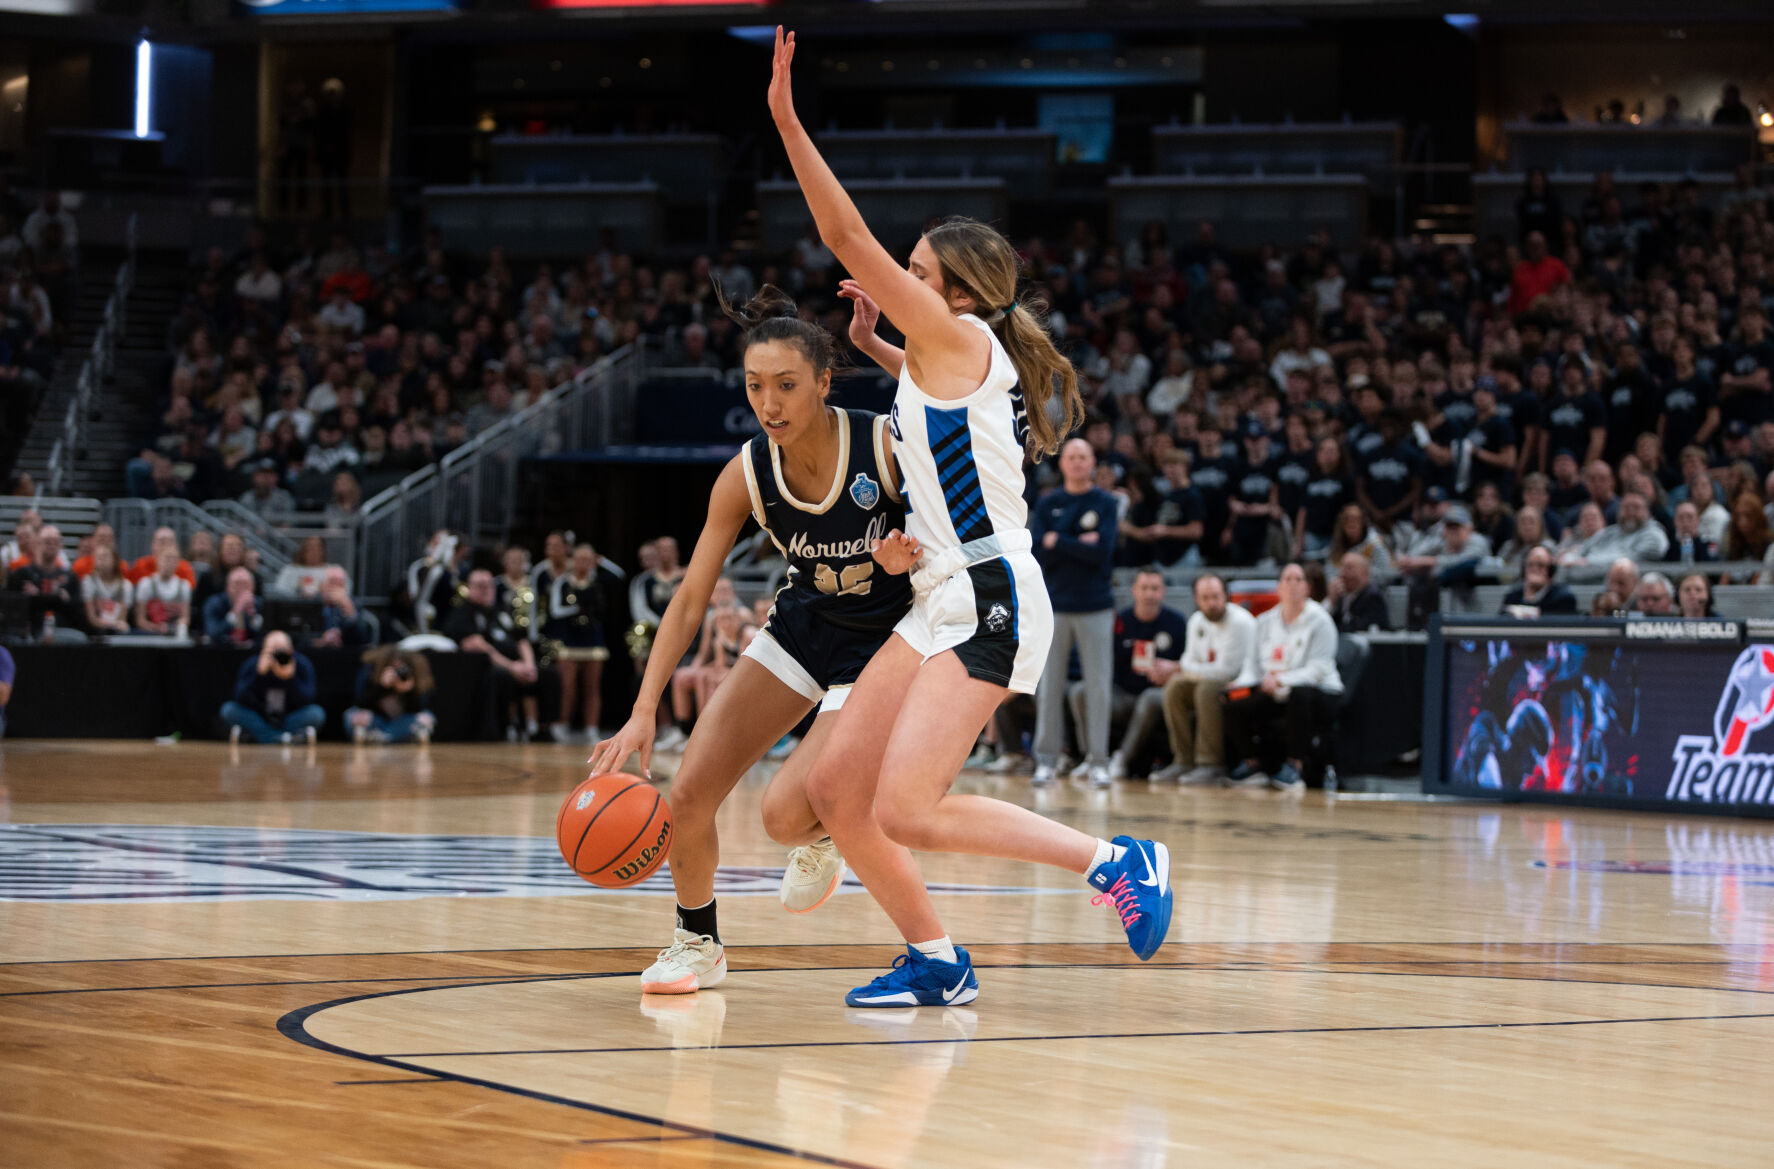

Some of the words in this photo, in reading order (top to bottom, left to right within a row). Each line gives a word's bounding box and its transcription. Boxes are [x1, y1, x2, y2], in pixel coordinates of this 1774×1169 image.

[789, 512, 887, 559] Norwell
[1665, 734, 1774, 804] Team
[613, 821, 670, 880] Wilson
